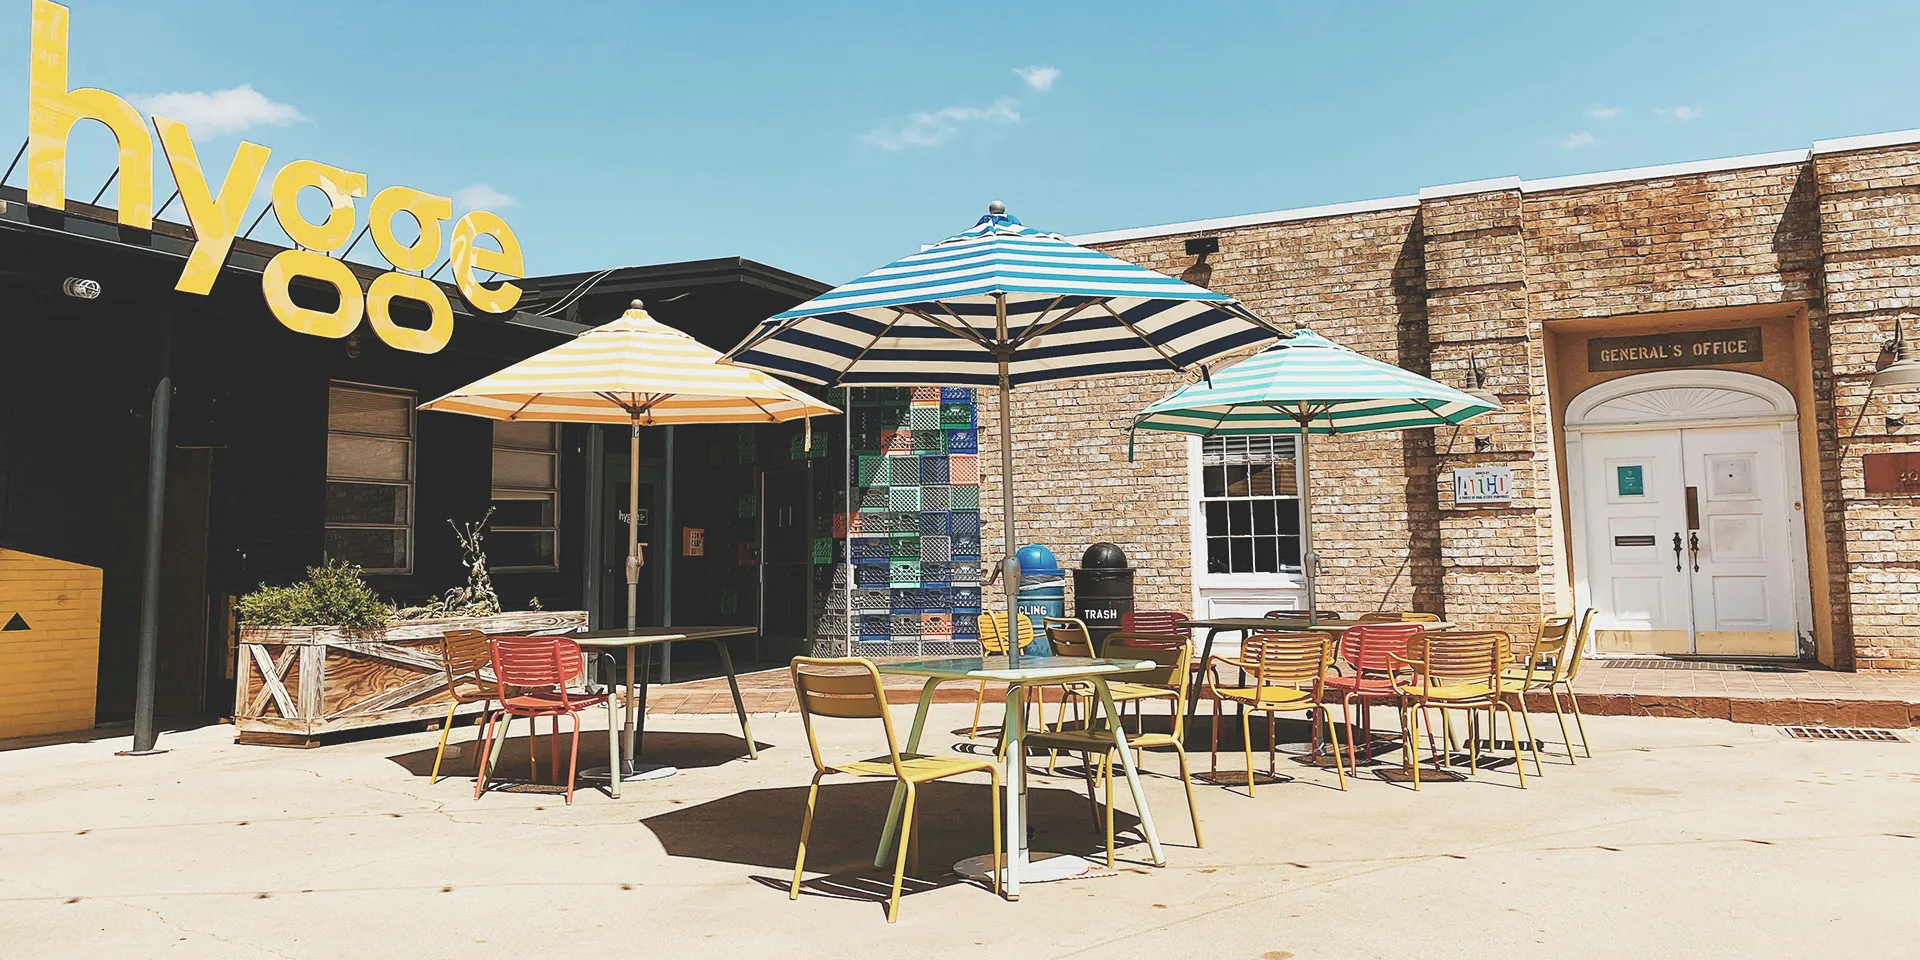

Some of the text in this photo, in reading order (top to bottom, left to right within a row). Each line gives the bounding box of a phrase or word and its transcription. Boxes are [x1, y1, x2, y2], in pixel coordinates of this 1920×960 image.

[27, 0, 525, 355] hygge
[1600, 340, 1748, 362] GENERAL'S OFFICE
[1084, 609, 1117, 619] TRASH
